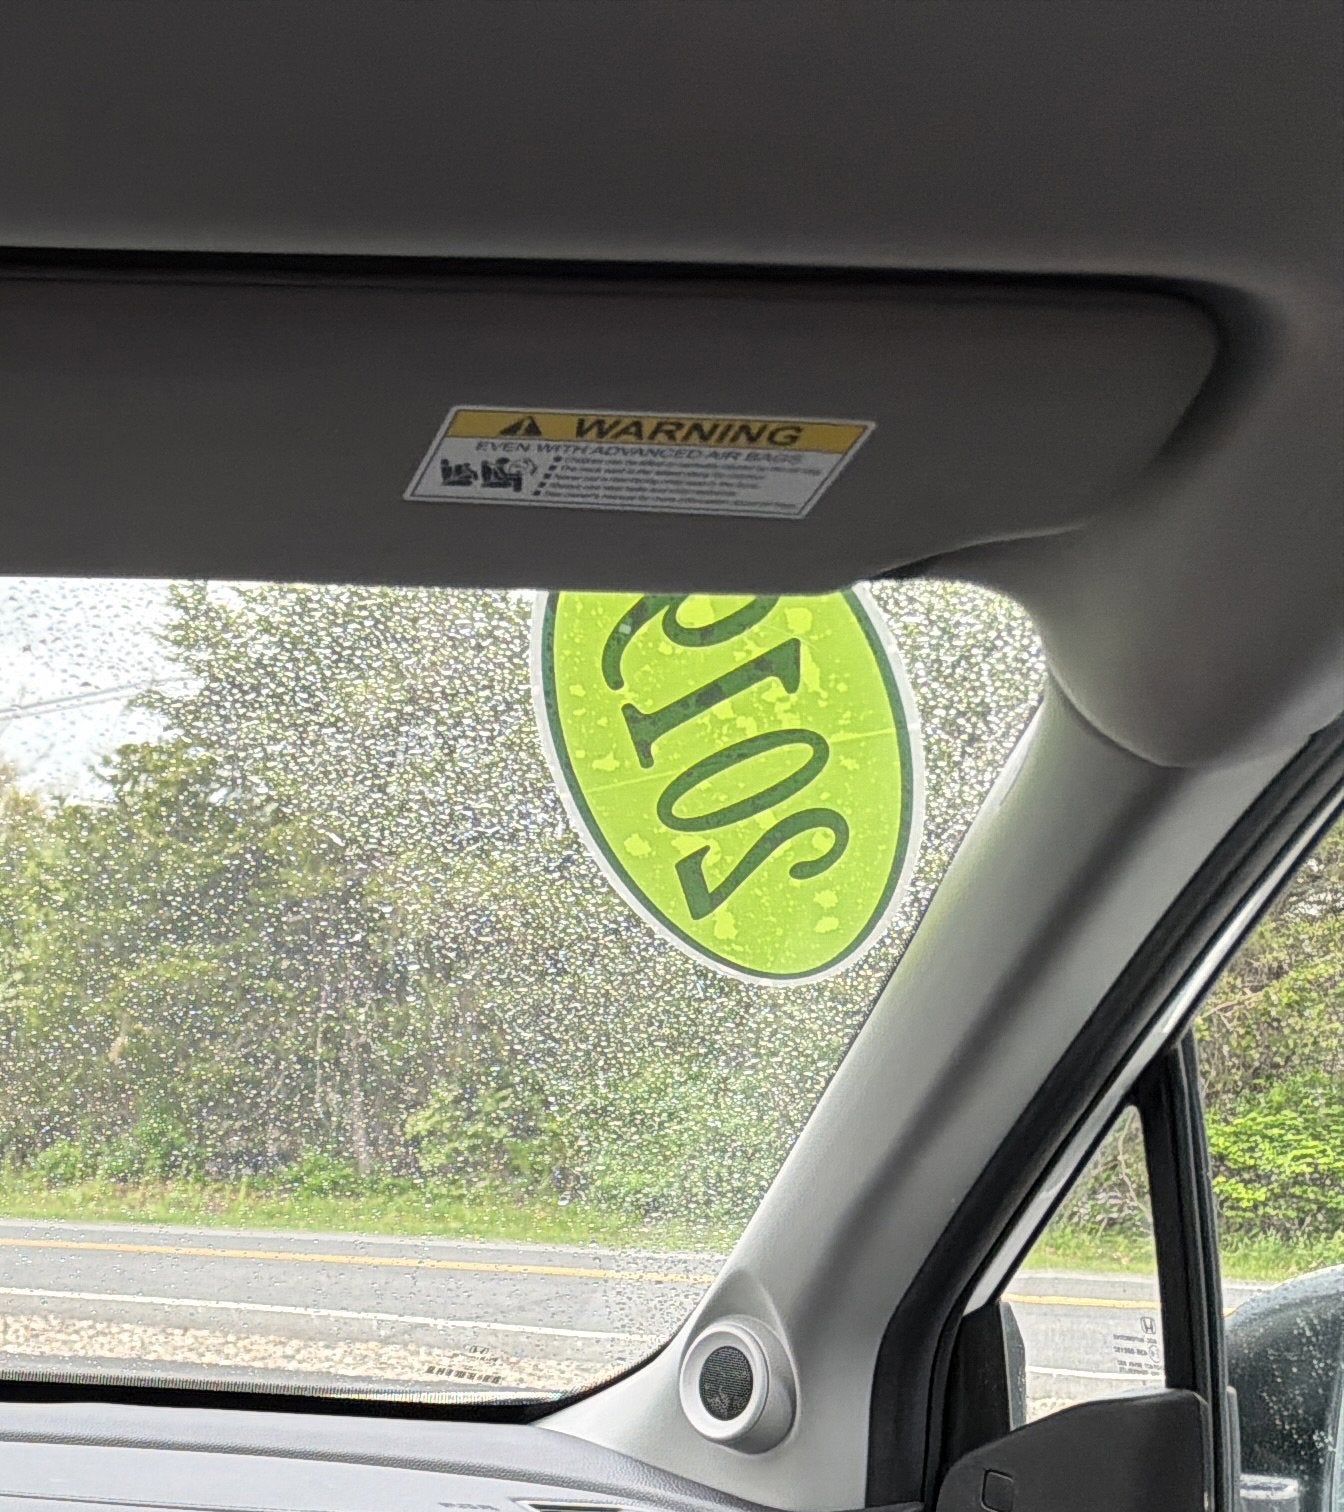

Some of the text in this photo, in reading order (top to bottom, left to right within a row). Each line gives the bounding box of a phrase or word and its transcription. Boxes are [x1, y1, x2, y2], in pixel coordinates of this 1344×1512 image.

[575, 417, 802, 447] WARNING
[475, 441, 803, 463] EVEN WITH ADVANCED AIR BAGS
